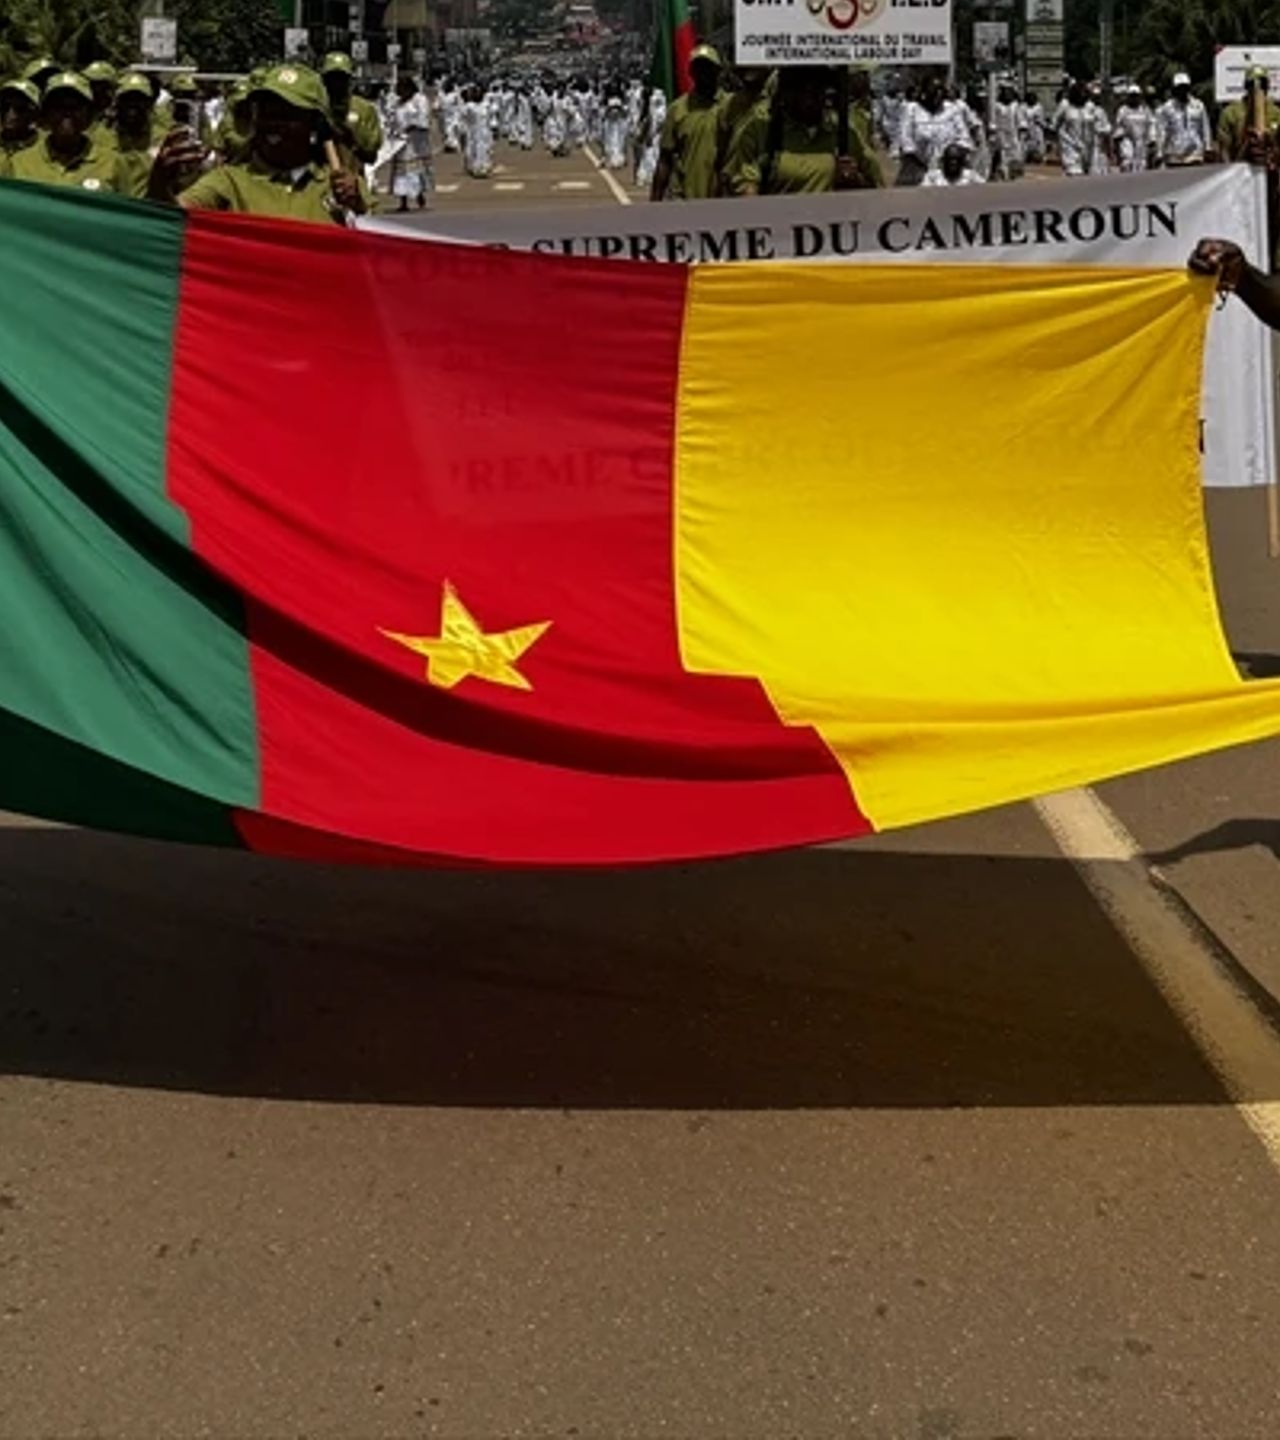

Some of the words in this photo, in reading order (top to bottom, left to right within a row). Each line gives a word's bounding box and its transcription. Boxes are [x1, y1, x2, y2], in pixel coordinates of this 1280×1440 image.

[885, 34, 899, 46] DU
[902, 34, 948, 46] TRAVAIL
[765, 47, 851, 60] INTERNATIONAL
[854, 47, 898, 59] LABOUR
[902, 47, 923, 59] DAY
[792, 221, 860, 258] DU
[877, 201, 1179, 253] CAMEROUN
